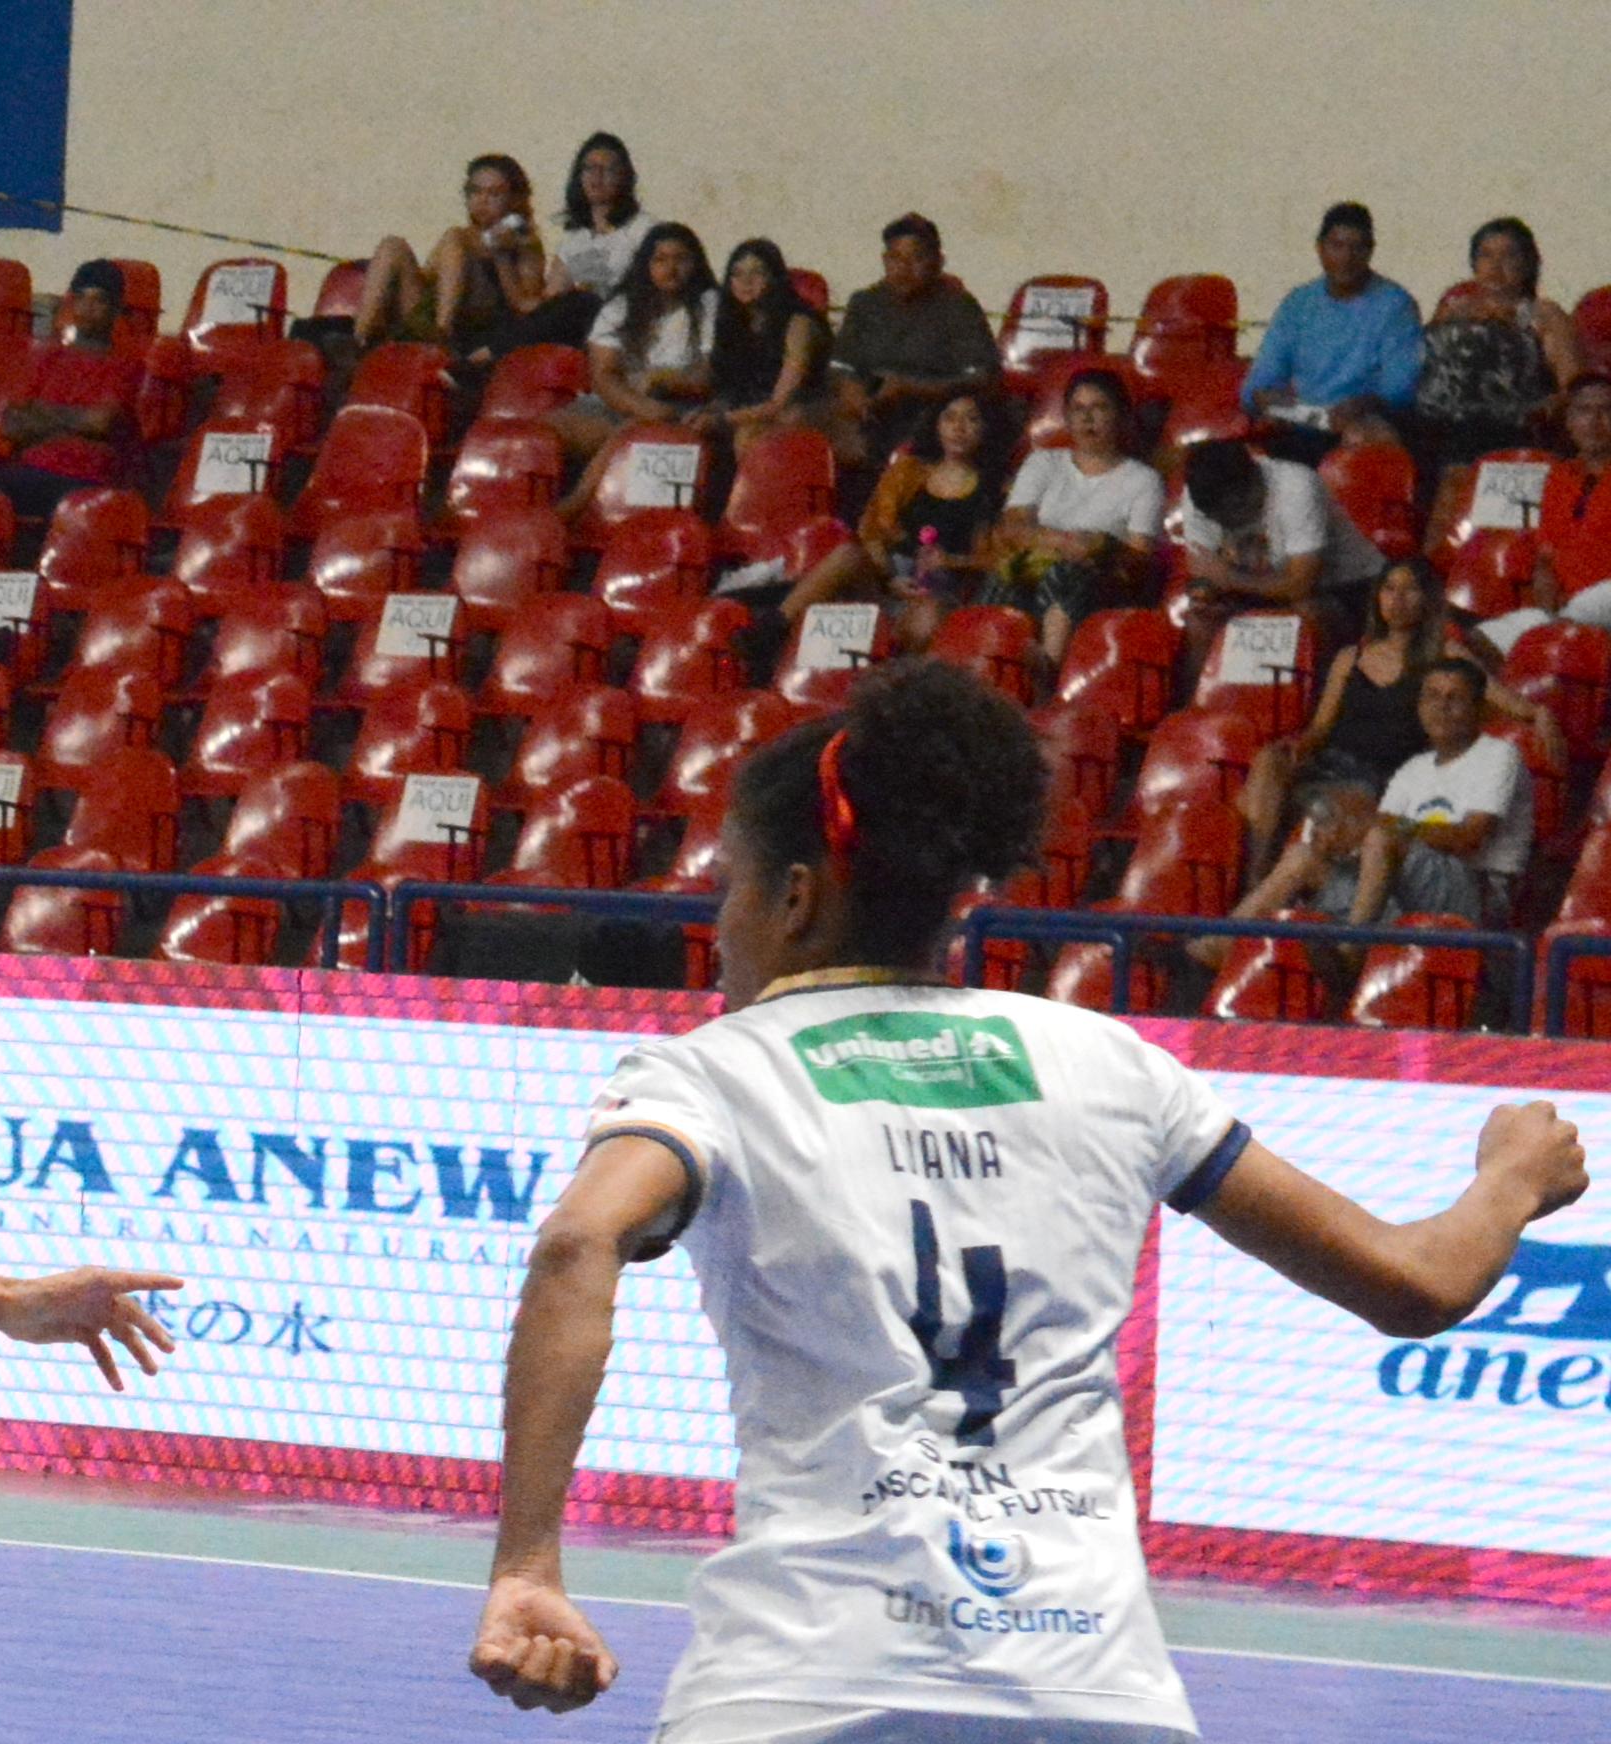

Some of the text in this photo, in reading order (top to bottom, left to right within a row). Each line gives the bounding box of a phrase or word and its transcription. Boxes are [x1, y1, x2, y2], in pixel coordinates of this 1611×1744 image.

[390, 612, 449, 632] AQUI
[810, 619, 871, 638] AQUI
[410, 791, 471, 812] AQUI
[804, 1028, 959, 1068] Unimed
[153, 1127, 553, 1223] ANEW
[883, 1123, 1002, 1179] LIANA
[910, 1198, 1017, 1447] 4
[1377, 1341, 1611, 1410] ane
